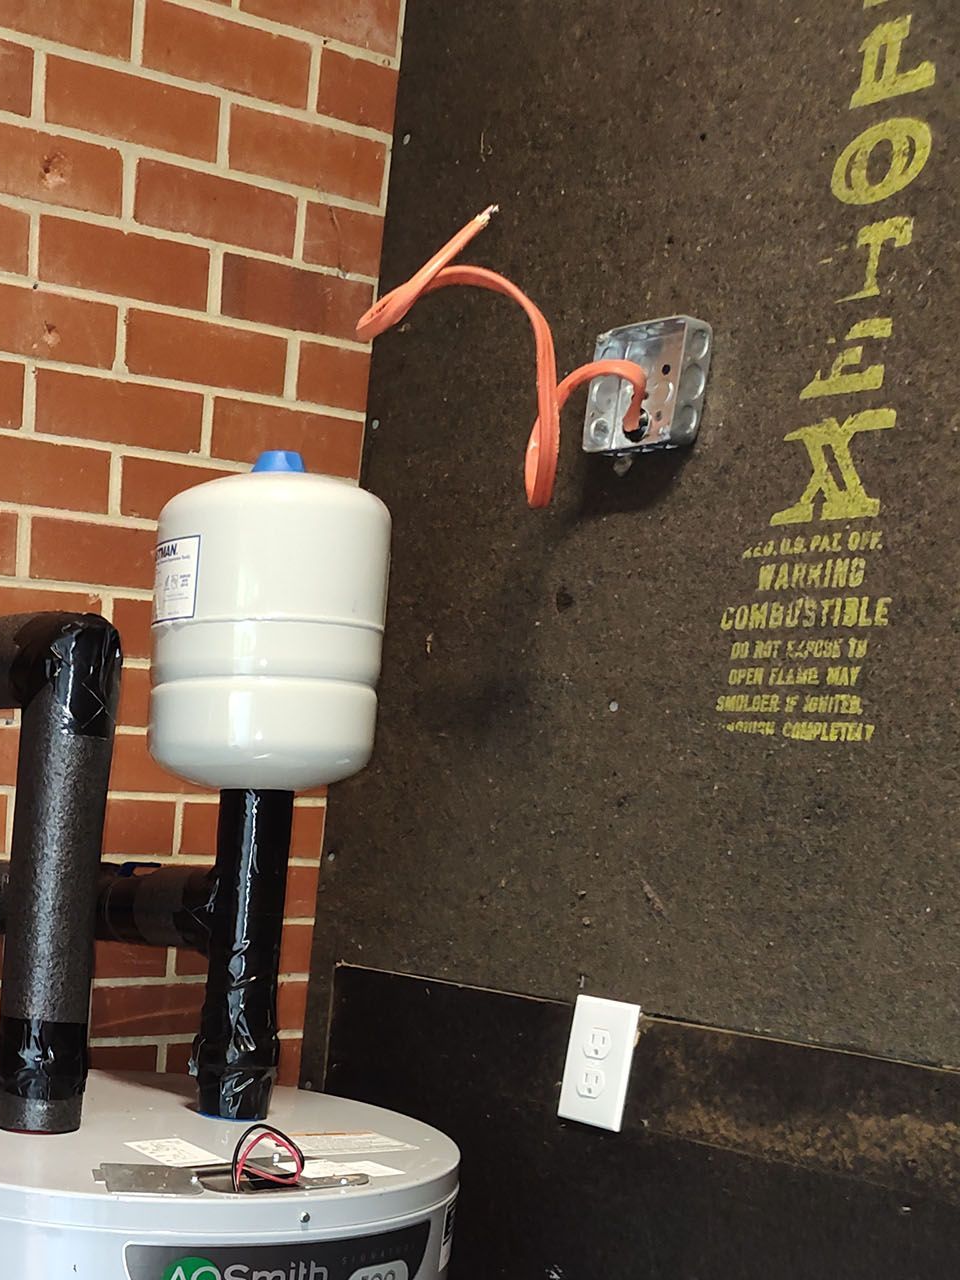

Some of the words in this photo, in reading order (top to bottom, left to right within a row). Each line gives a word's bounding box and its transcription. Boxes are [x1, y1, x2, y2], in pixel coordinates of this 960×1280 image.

[758, 556, 867, 591] WARNING
[720, 596, 893, 632] COMBUSTIBLE
[730, 641, 750, 660] DO
[753, 639, 782, 659] NOT
[728, 667, 765, 686] OPEN
[826, 665, 862, 687] MAY
